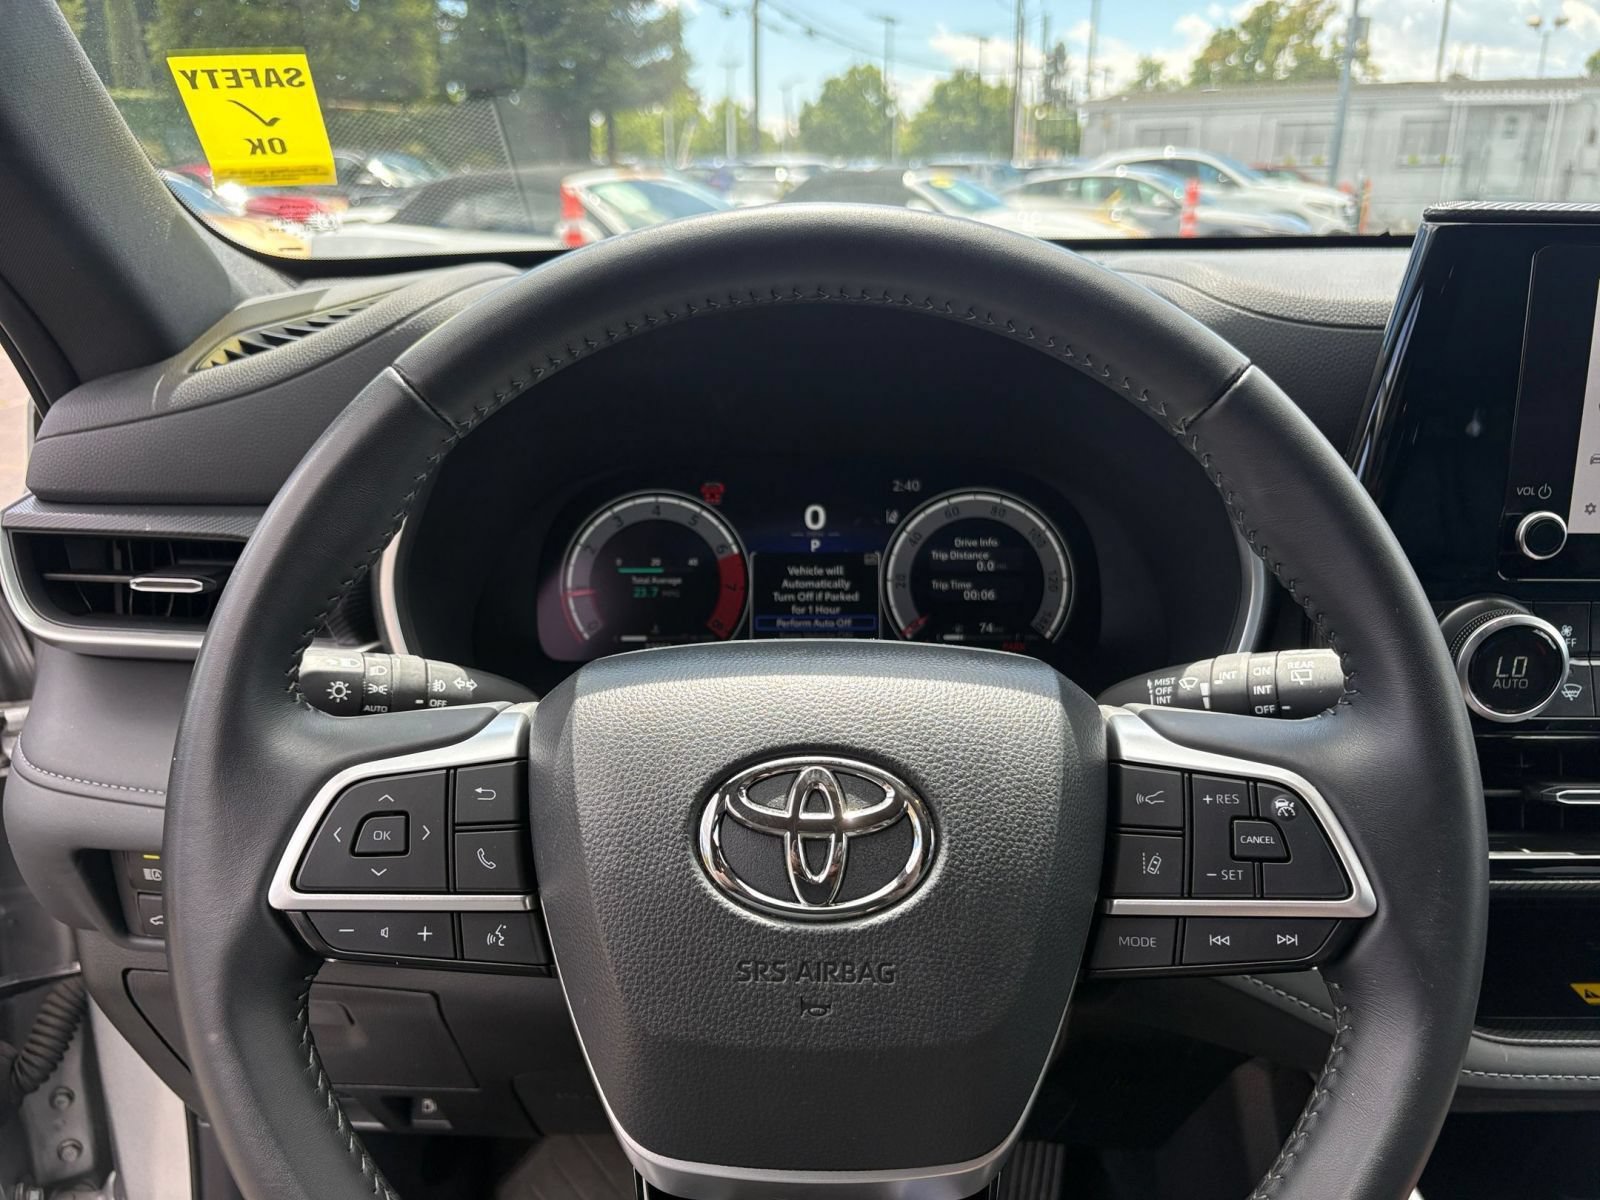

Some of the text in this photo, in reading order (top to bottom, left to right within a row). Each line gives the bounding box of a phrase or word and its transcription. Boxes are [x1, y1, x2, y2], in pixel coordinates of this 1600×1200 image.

[893, 481, 920, 492] 2:40
[1516, 486, 1536, 496] VOL
[652, 505, 661, 517] 4
[614, 516, 624, 527] 3
[688, 515, 699, 526] 5
[804, 505, 827, 530] 0
[908, 532, 922, 547] 40
[954, 538, 998, 547] Drive Info
[810, 539, 821, 552] P
[931, 550, 990, 561] Trip Distance
[787, 566, 843, 576] Vehicle will
[977, 561, 995, 571] 0.0
[782, 579, 851, 590] Automatically
[931, 580, 971, 591] Trip Time
[773, 591, 859, 602] Turn Off if Parked
[963, 590, 996, 601] 00:06
[792, 605, 806, 615] for
[815, 605, 841, 614] Hour
[776, 618, 811, 628] Perform
[813, 618, 835, 628] Auto
[1565, 638, 1577, 648] FF
[1288, 661, 1314, 669] REAR
[1219, 671, 1238, 681] INT
[1253, 667, 1271, 676] ON
[1154, 677, 1176, 686] MIST
[1492, 679, 1529, 689] AUTO
[1155, 687, 1173, 695] OFF
[1253, 685, 1272, 695] INT
[429, 699, 447, 708] OFF
[1156, 696, 1172, 704] INT
[363, 704, 388, 713] AUTO
[1254, 705, 1275, 714] OFF
[1216, 793, 1240, 805] RES
[373, 830, 391, 841] OK
[1240, 835, 1275, 845] CANCEL
[1221, 869, 1244, 880] SET
[1118, 936, 1157, 948] MODE
[736, 961, 897, 985] SRS AIRBAG
